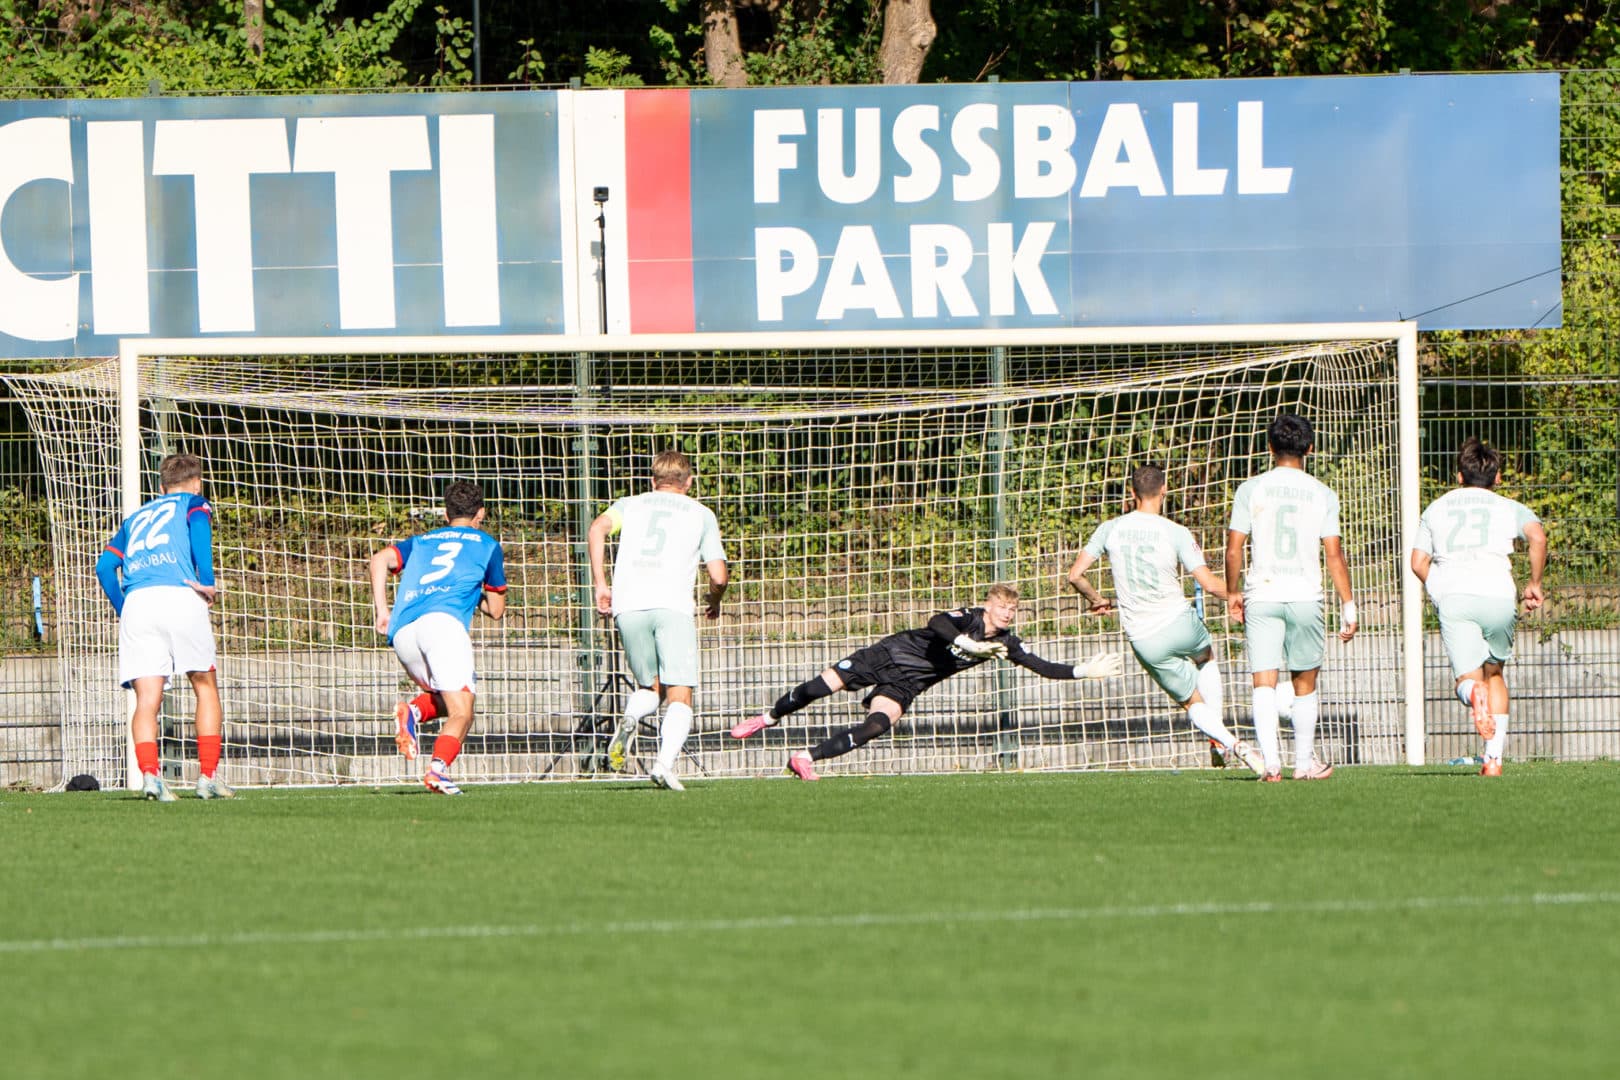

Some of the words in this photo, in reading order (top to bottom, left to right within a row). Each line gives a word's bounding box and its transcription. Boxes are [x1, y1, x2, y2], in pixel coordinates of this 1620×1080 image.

[753, 100, 1293, 204] FUSSBALL
[0, 114, 500, 342] CITTI
[754, 221, 1060, 322] PARK
[127, 502, 177, 558] 22
[640, 511, 673, 557] 5
[1274, 505, 1298, 560] 6
[1446, 507, 1491, 553] 23
[419, 541, 464, 585] 3
[1119, 545, 1160, 592] 16
